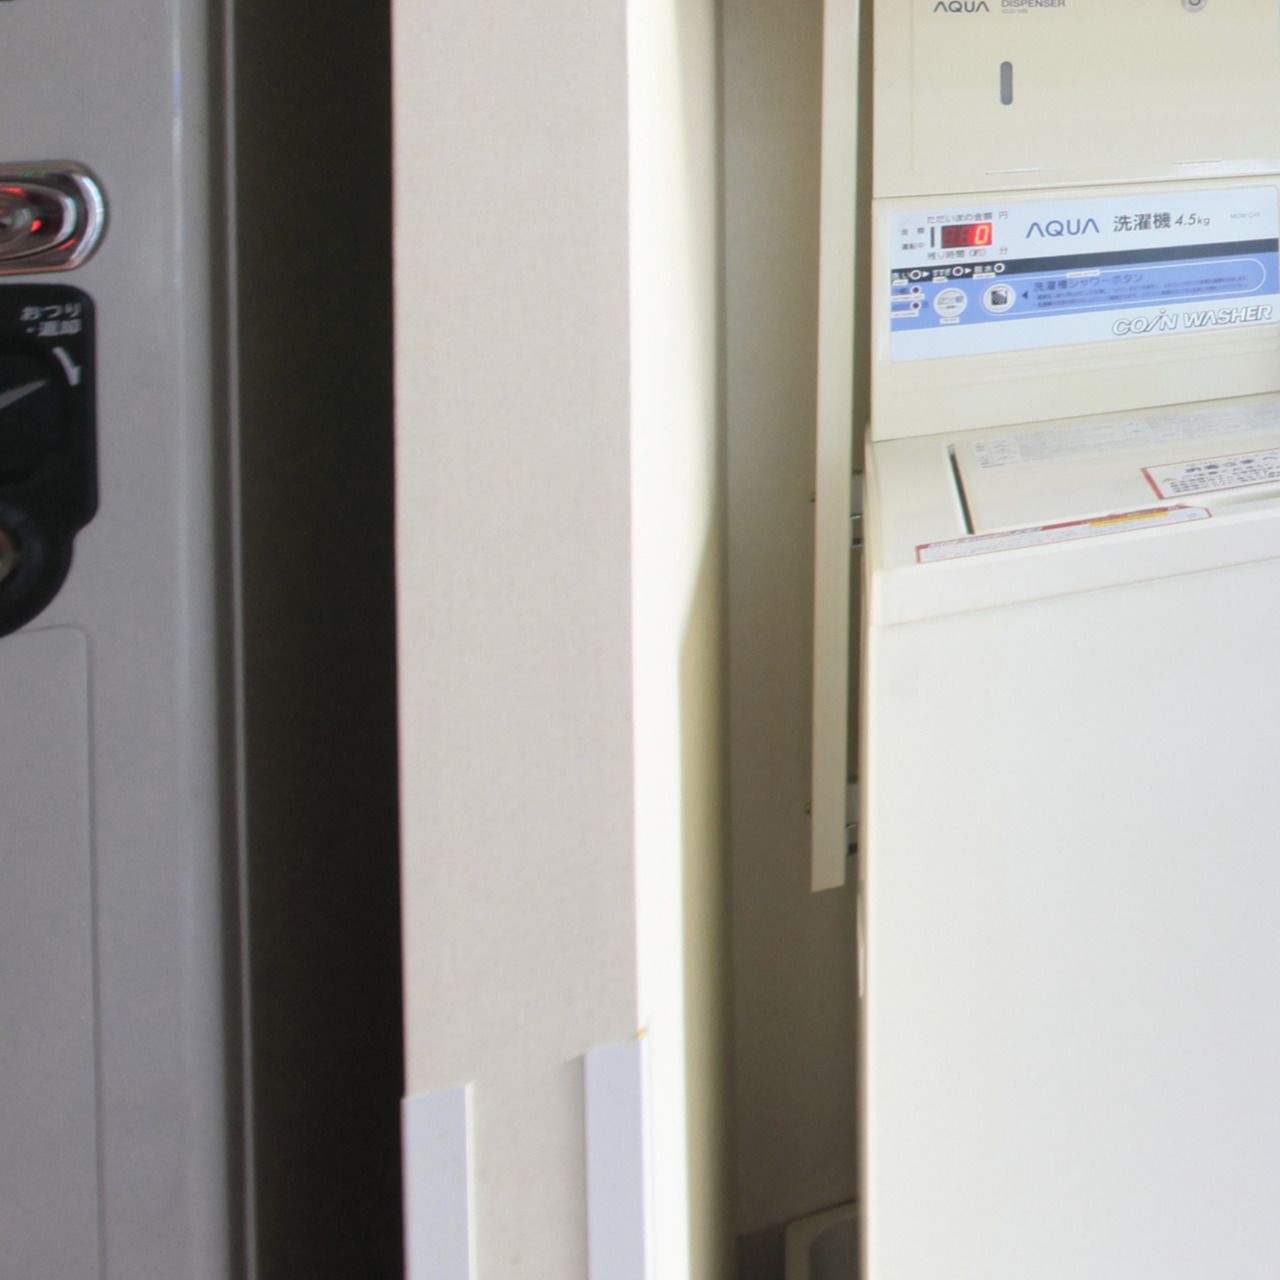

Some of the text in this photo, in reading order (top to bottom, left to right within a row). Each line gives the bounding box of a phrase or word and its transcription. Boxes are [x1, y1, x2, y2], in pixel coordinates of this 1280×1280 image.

[933, 0, 1066, 13] AQUA DISPENSER
[974, 225, 989, 245] 0
[1026, 218, 1100, 239] AQUA
[1113, 212, 1172, 232] 洗濯機
[1034, 274, 1143, 292] 洗濯槽シャワーボタン
[20, 302, 81, 321] おつり
[1182, 304, 1273, 329] WASHER
